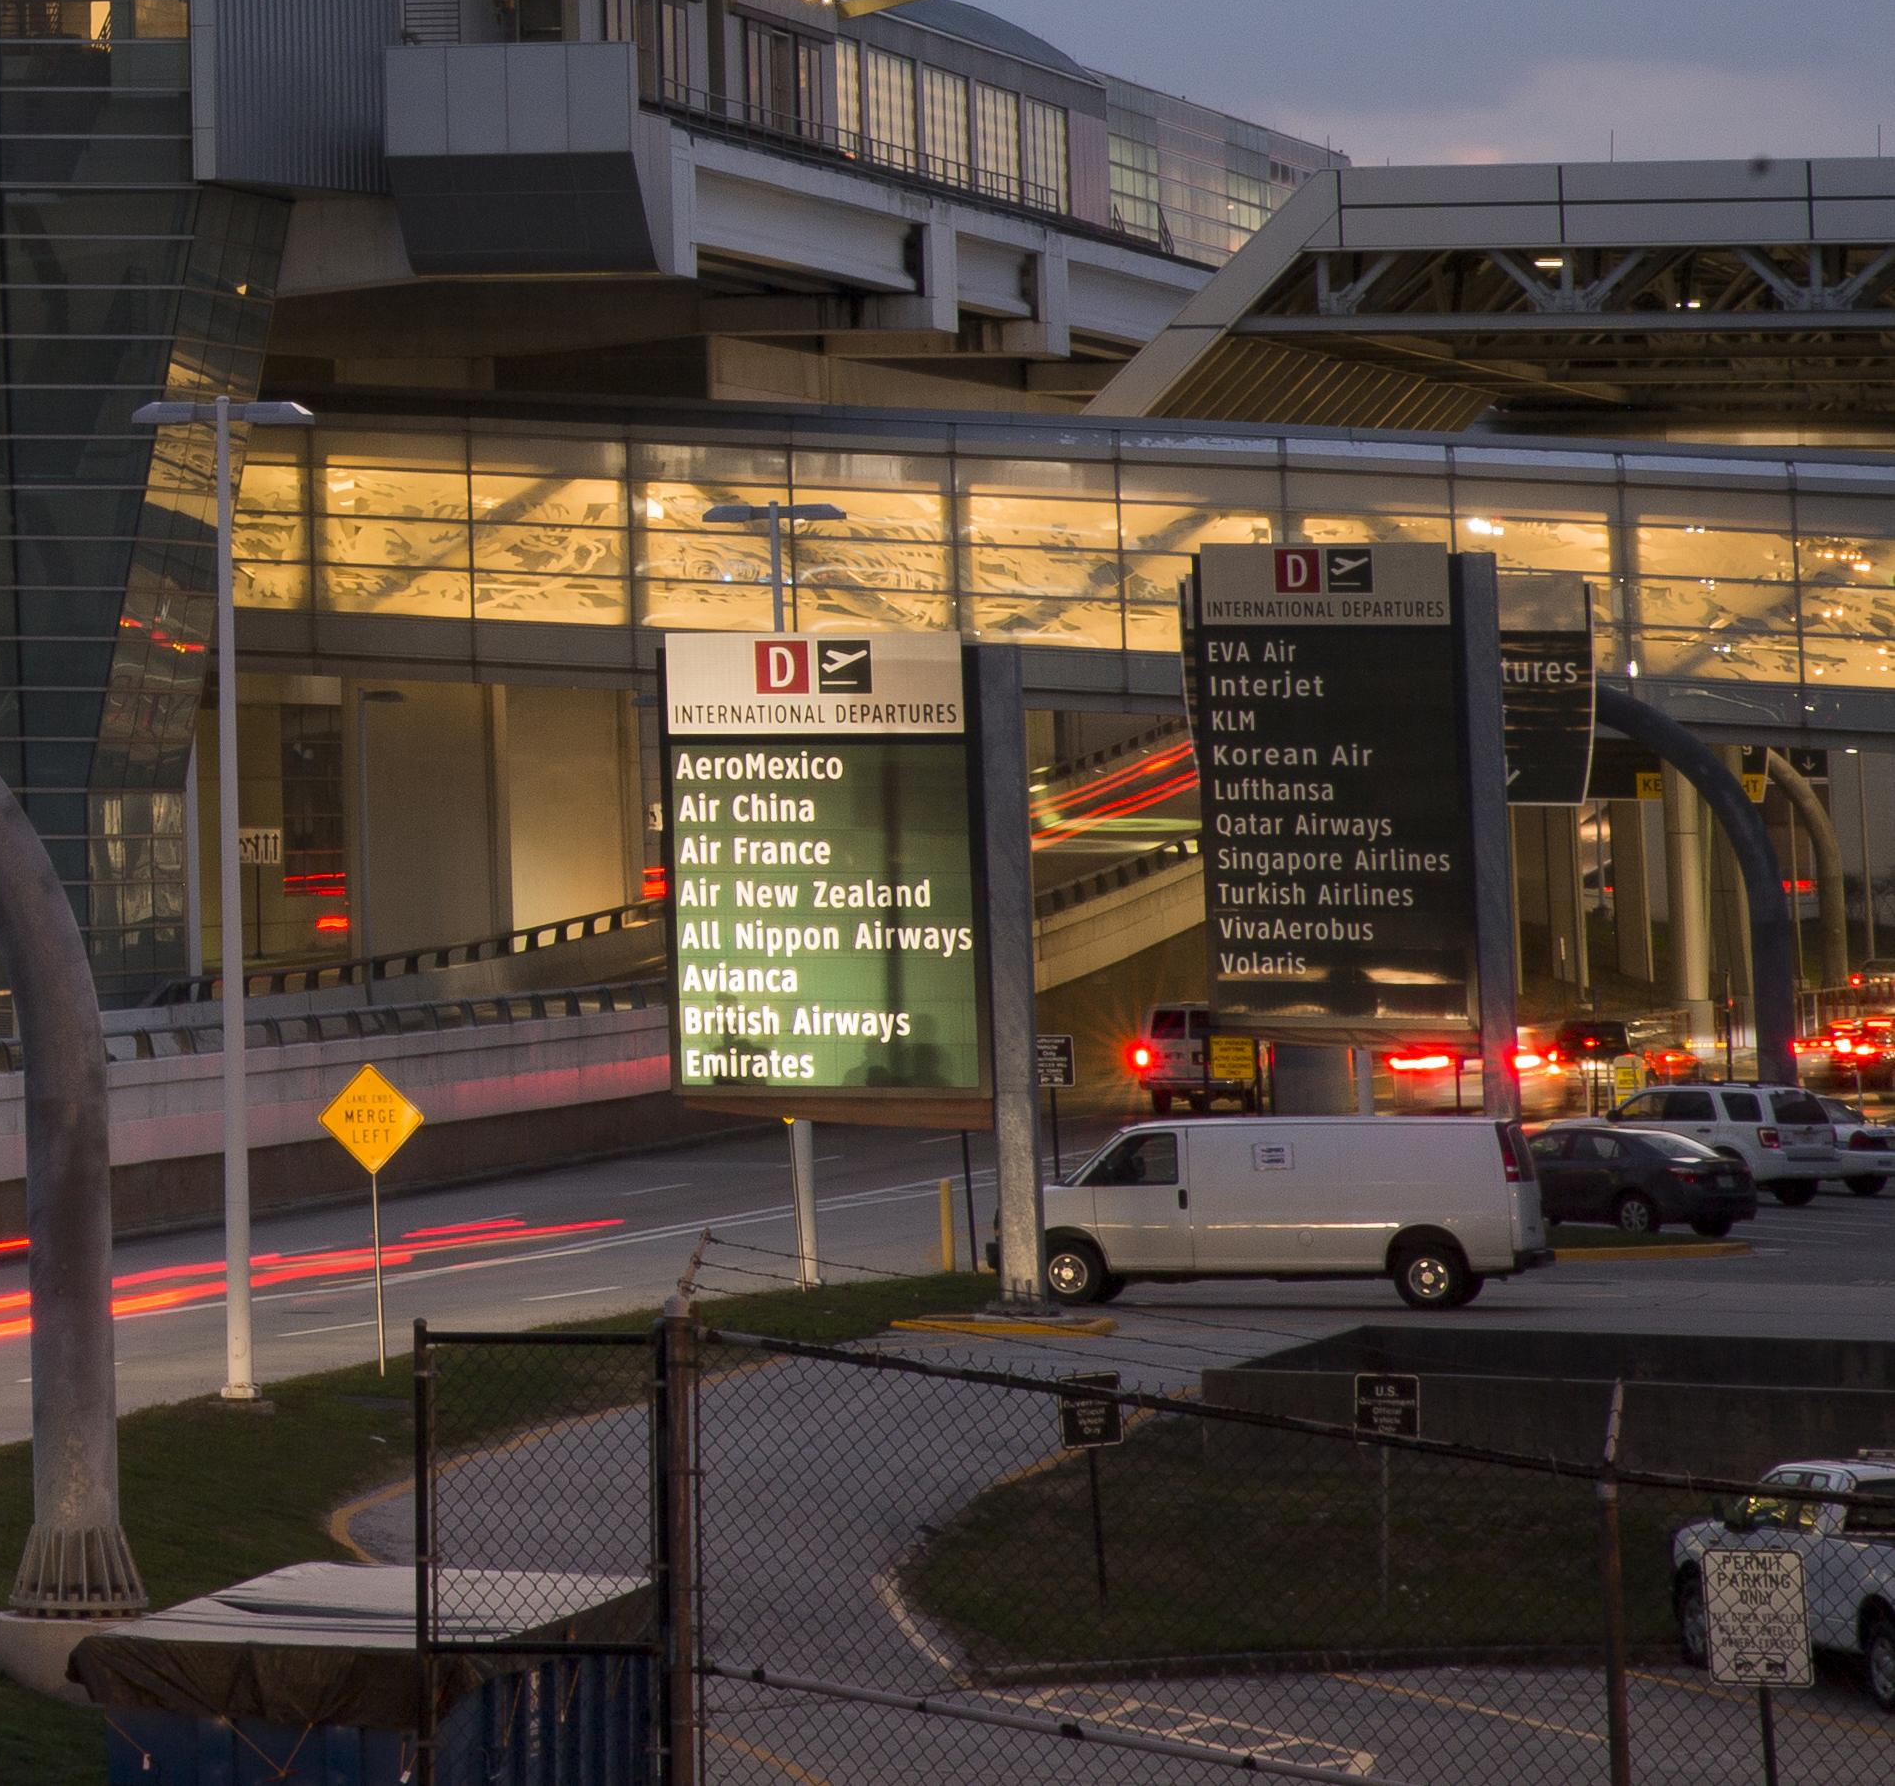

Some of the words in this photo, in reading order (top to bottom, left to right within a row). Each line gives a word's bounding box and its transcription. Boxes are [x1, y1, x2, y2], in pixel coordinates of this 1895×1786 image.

[1287, 554, 1308, 588] D
[1206, 600, 1334, 618] INTERNATIONAL
[1342, 600, 1445, 618] DEPARTURES
[1208, 641, 1250, 663] EVA
[1263, 640, 1297, 663] Air
[768, 646, 796, 688] D
[1500, 657, 1579, 684] tures
[1210, 671, 1325, 699] Interjet
[675, 704, 825, 724] INTERNATIONAL
[836, 703, 957, 724] DEPARTURES
[1211, 710, 1256, 732] KLM
[676, 750, 844, 780] AeroMexico
[1213, 744, 1317, 766] Korean
[1331, 743, 1373, 766] Air
[1214, 778, 1335, 801] Lufthansa
[678, 792, 721, 822] Air
[732, 792, 816, 822] China
[1216, 814, 1284, 837] Qatar
[1295, 813, 1392, 842] Airways
[679, 835, 721, 865] Air
[733, 837, 831, 865] France
[1217, 848, 1343, 875] Singapore
[1354, 849, 1450, 872] Airlines
[679, 877, 721, 907] Air
[734, 880, 799, 908] New
[812, 878, 931, 908] Zealand
[1218, 882, 1307, 905] Turkish
[1318, 883, 1414, 906] Airlines
[681, 920, 721, 950] All
[734, 920, 840, 957] Nippon
[854, 920, 973, 957] Airways
[1219, 917, 1374, 941] VivaAerobus
[1220, 952, 1307, 976] Volaris
[682, 962, 798, 992] Avianca
[684, 1004, 780, 1035] British
[792, 1005, 911, 1043] Airways
[685, 1048, 815, 1078] Emirates
[372, 1094, 393, 1104] ENDS
[345, 1109, 396, 1123] MERGE
[352, 1129, 390, 1143] LEFT
[1722, 1555, 1782, 1571] PERMIT
[1717, 1572, 1791, 1589] PARKING
